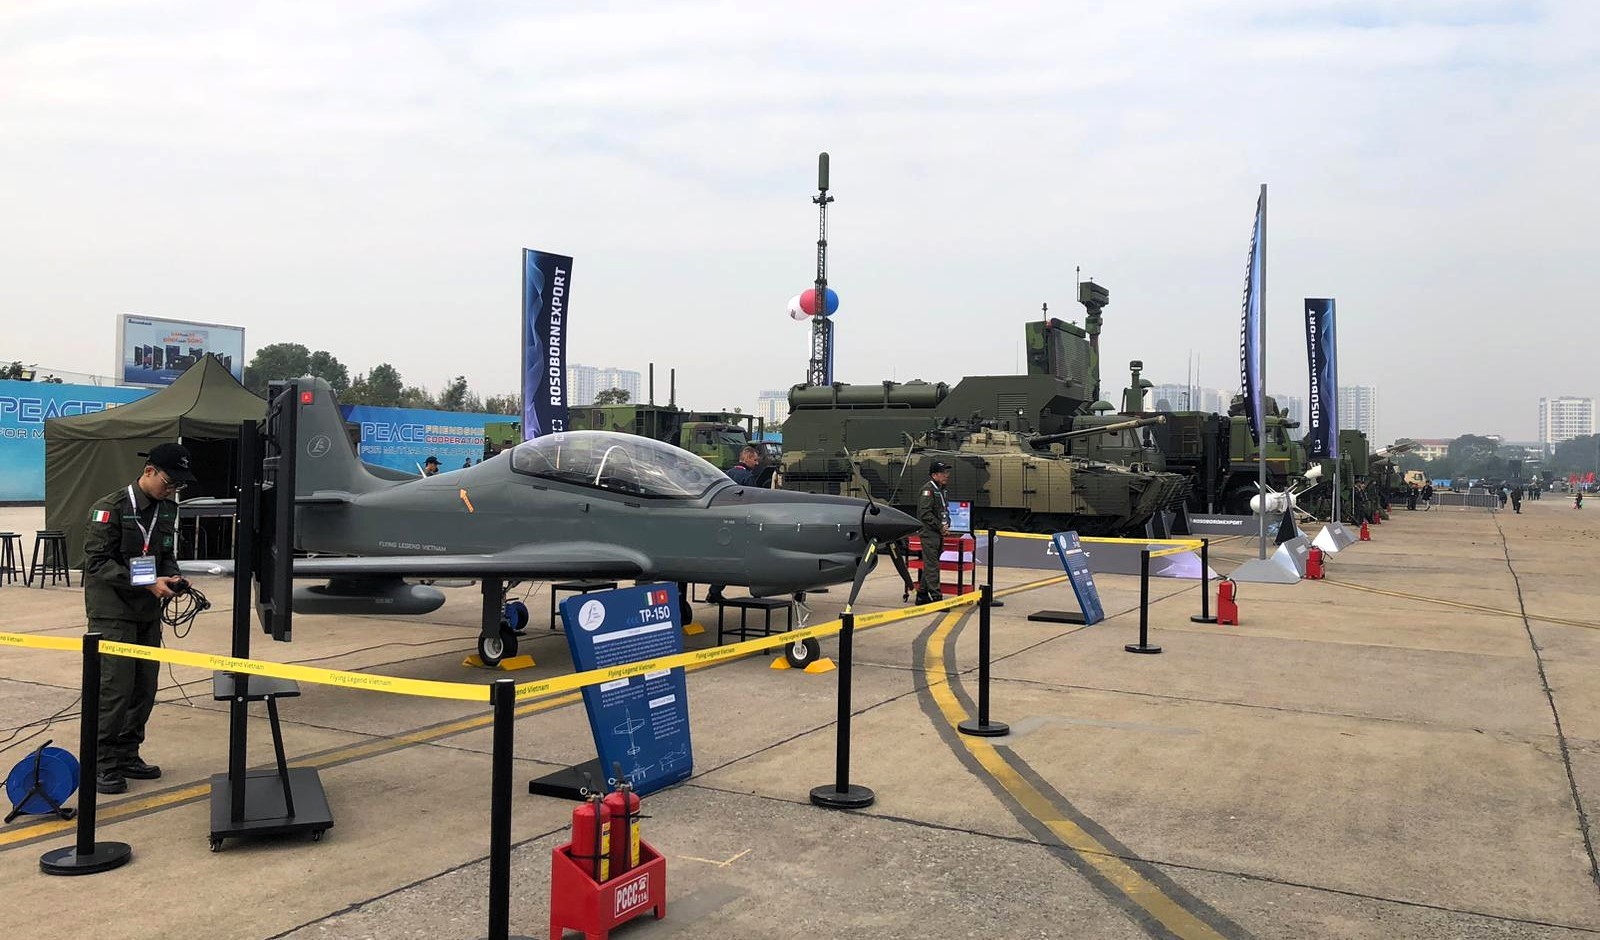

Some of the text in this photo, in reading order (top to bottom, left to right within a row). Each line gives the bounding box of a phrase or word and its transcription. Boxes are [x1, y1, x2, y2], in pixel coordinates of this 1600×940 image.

[361, 421, 425, 442] PEACE
[639, 605, 670, 622] TP-150
[210, 657, 265, 670] Flying Legend Vietnam
[608, 668, 621, 678] Flying
[622, 666, 638, 675] Legend
[330, 673, 392, 686] Flying Legend Vietnam
[527, 684, 549, 694] Vietnam
[616, 881, 648, 912] PCCC 114
